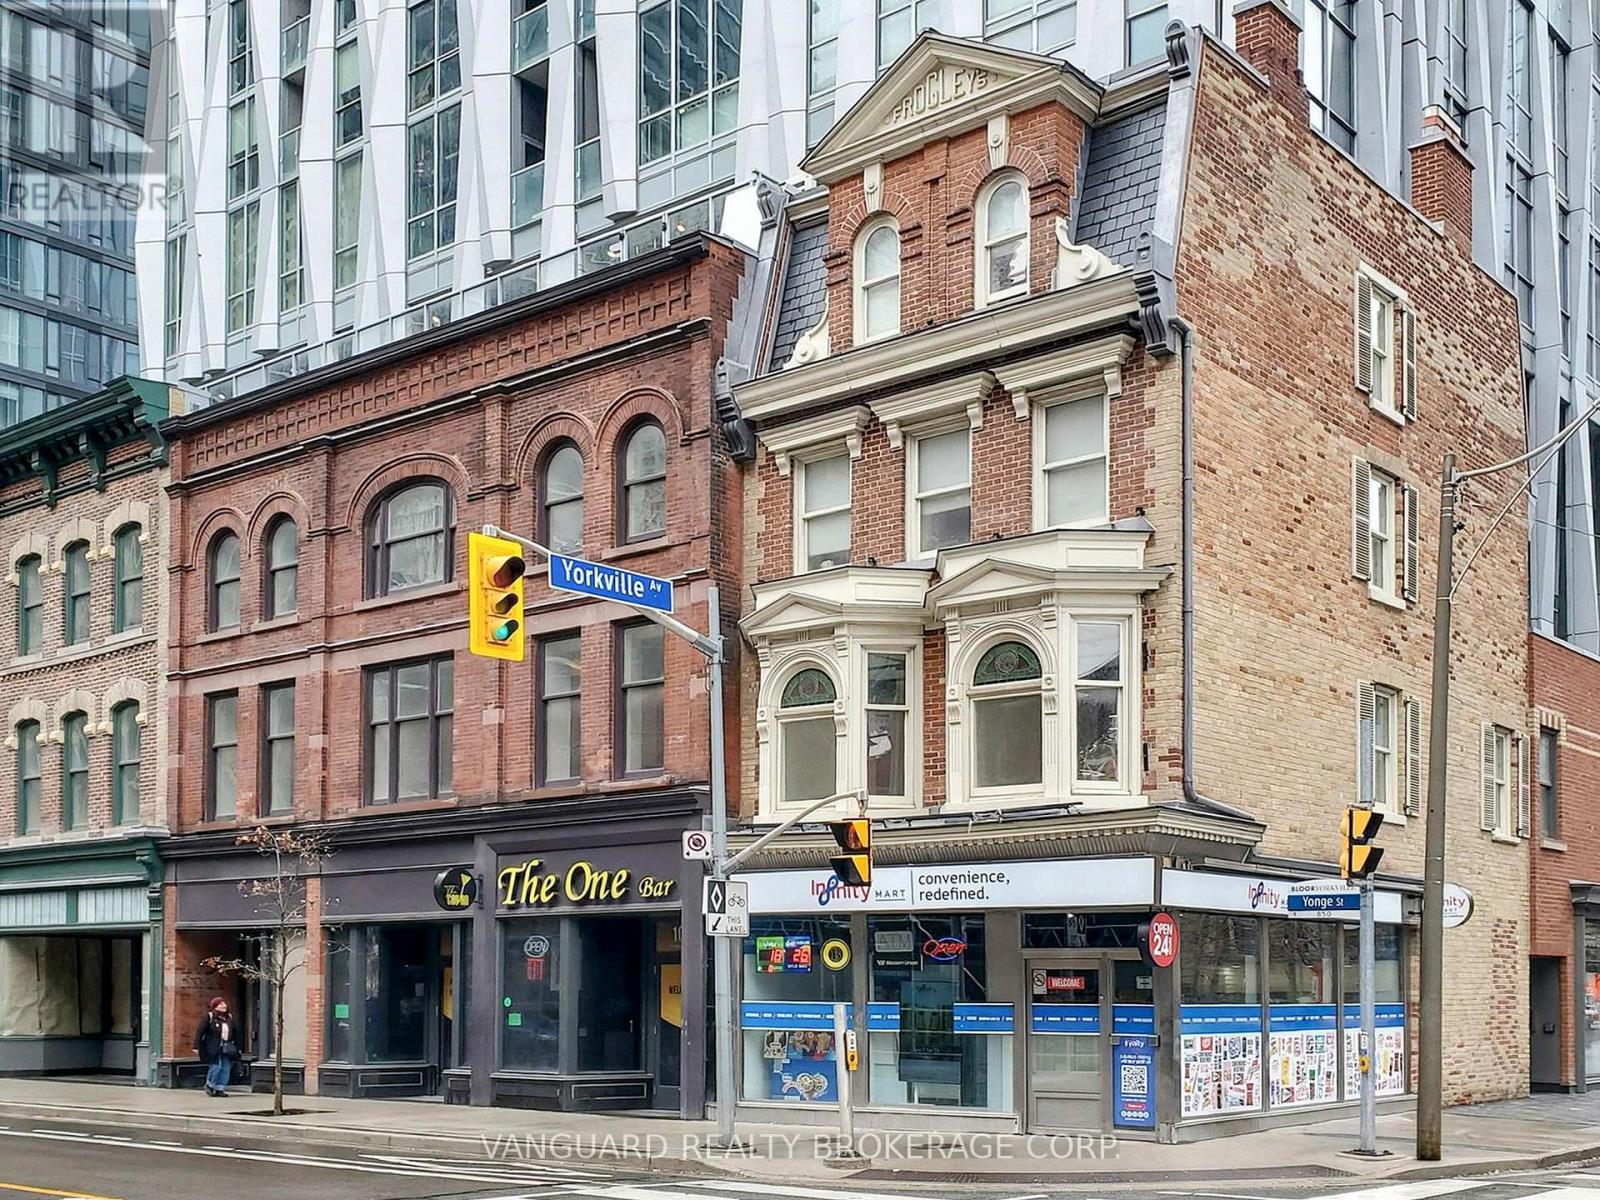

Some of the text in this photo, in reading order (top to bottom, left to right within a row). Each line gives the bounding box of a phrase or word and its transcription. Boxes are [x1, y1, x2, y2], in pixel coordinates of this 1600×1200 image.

[561, 558, 662, 598] Yorkville Av
[497, 858, 675, 906] The One Bar
[918, 870, 1011, 886] convenience,
[875, 889, 906, 899] MART
[919, 886, 990, 902] redefined.
[1302, 896, 1344, 910] Yonge St
[727, 916, 741, 925] THIS
[1153, 922, 1172, 936] OPEN
[923, 939, 967, 956] Open
[1153, 934, 1169, 956] 24
[769, 948, 784, 963] 18
[1052, 977, 1082, 987] WELCOME
